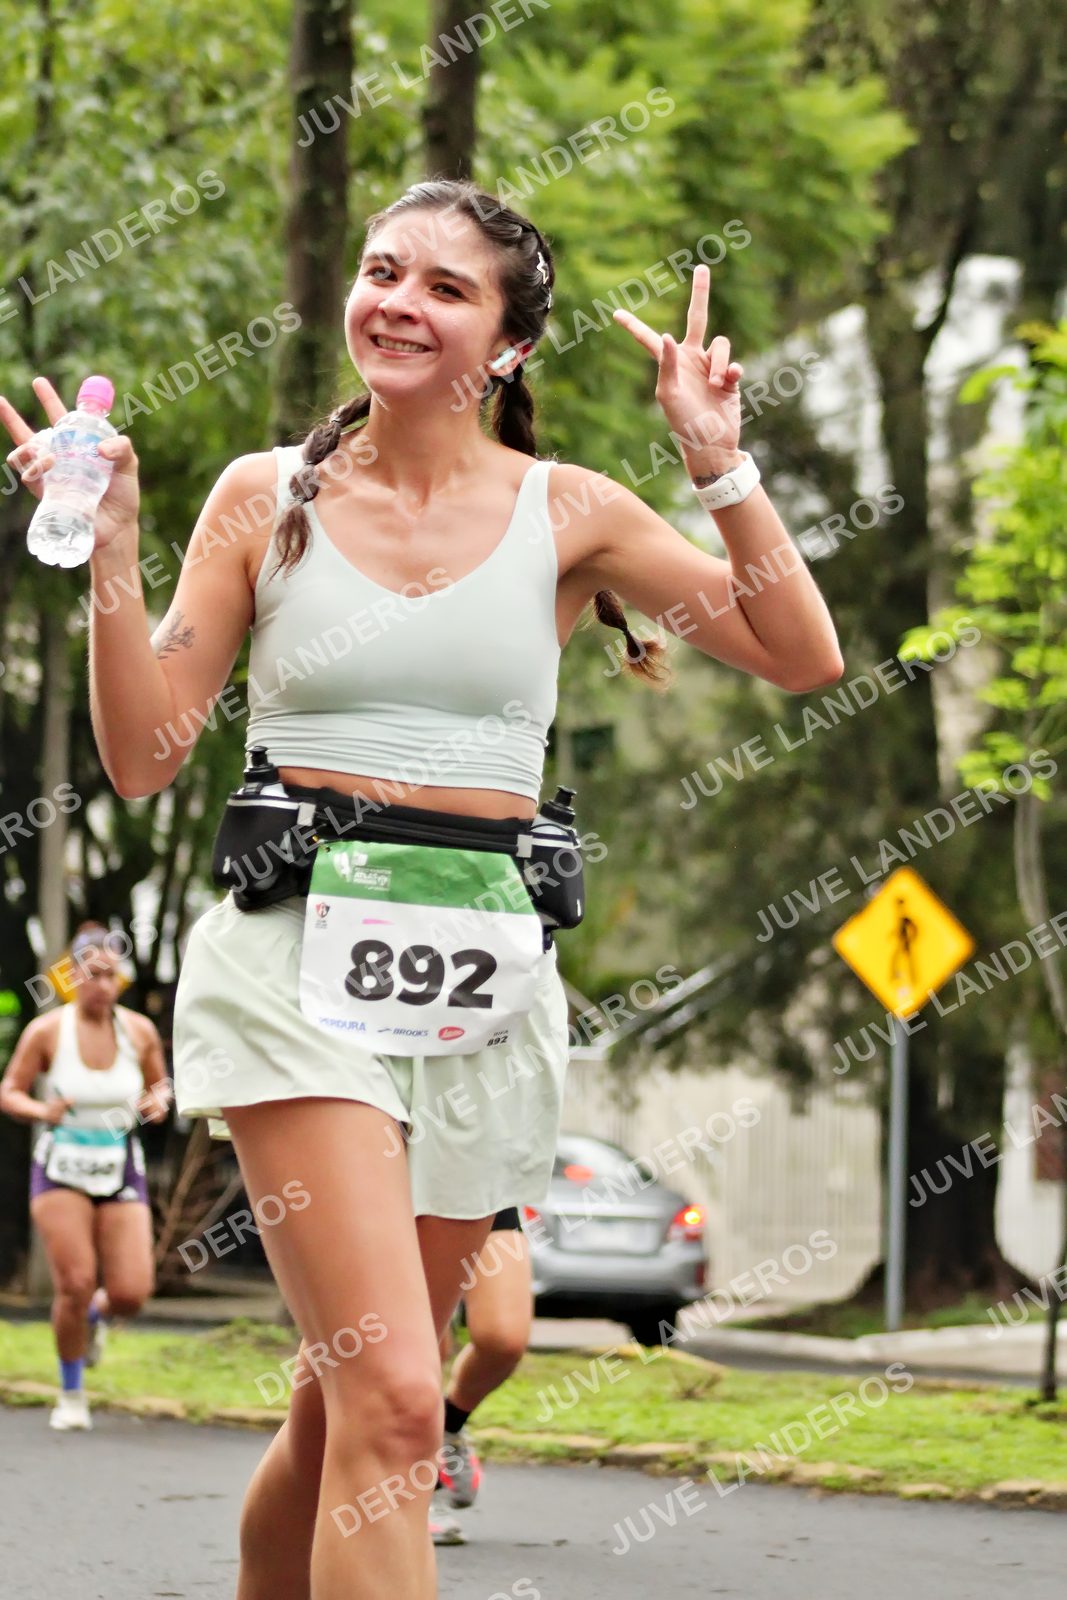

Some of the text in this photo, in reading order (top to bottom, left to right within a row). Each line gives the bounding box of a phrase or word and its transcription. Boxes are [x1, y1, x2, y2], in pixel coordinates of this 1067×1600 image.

[344, 939, 498, 1009] 892
[393, 1028, 429, 1038] BROOKS
[486, 1035, 508, 1047] 892
